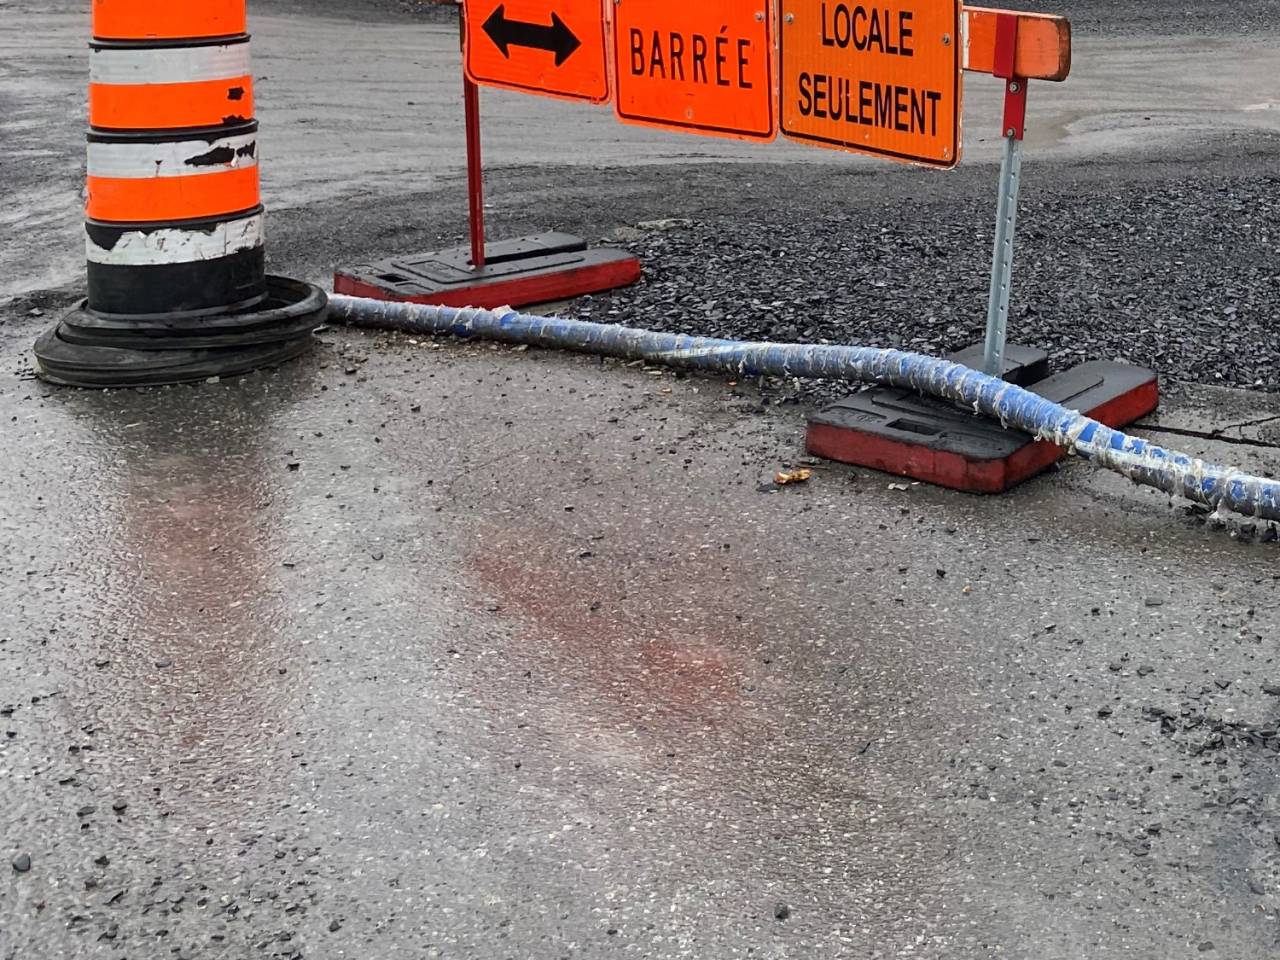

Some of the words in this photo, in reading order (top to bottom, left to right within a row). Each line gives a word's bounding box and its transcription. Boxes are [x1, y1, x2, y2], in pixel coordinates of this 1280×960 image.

[630, 25, 754, 90] BARRÉE
[820, 1, 914, 57] LOCALE
[797, 71, 942, 137] SEULEMENT
